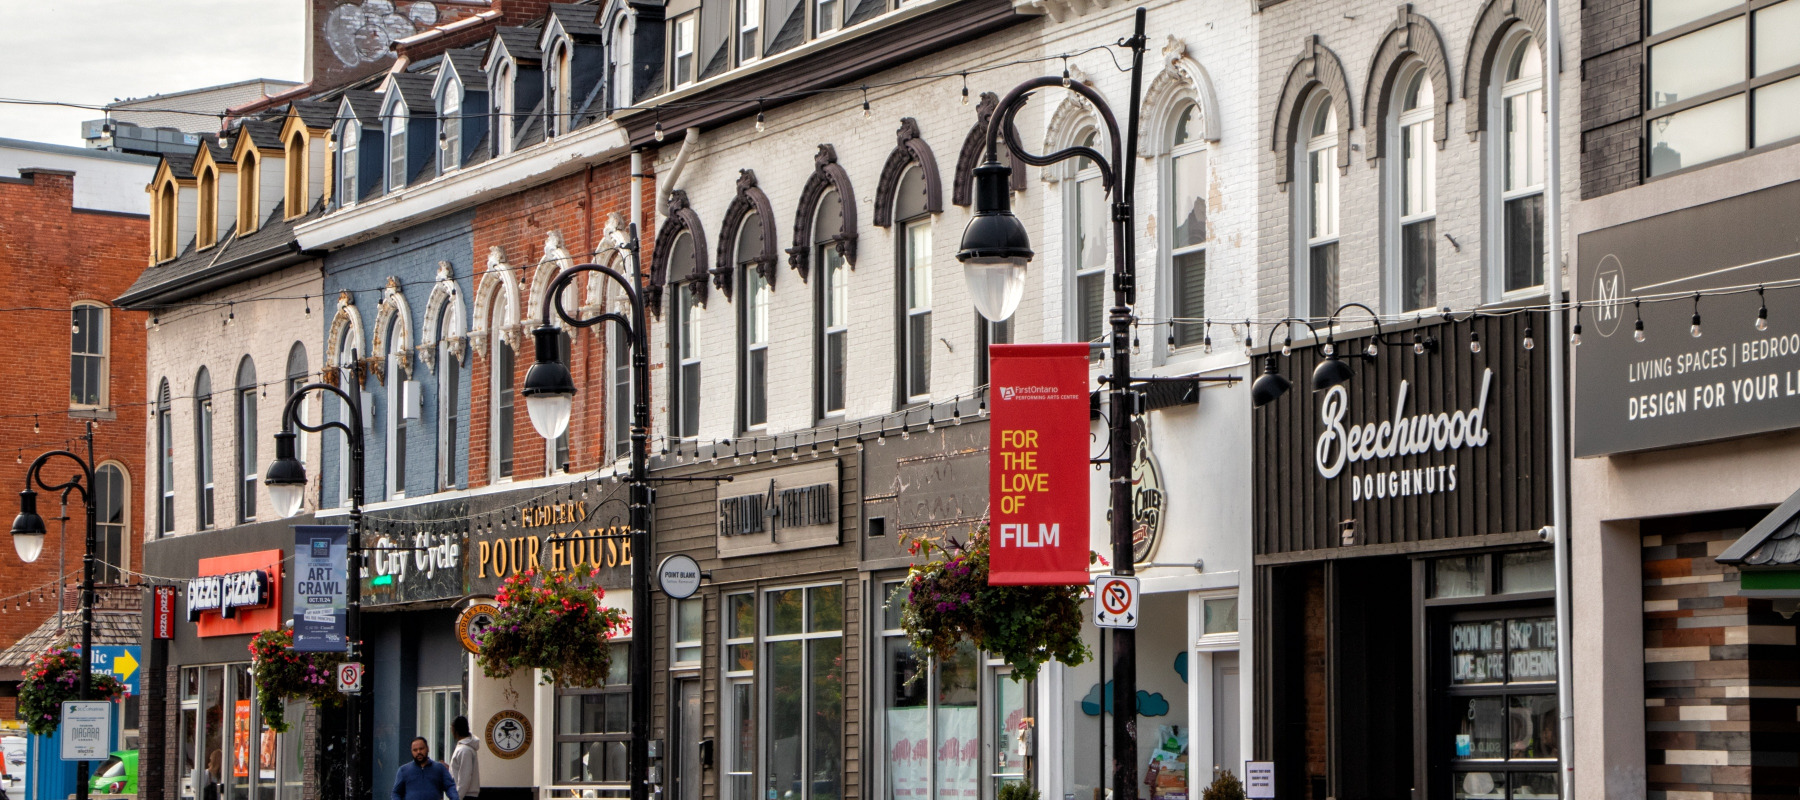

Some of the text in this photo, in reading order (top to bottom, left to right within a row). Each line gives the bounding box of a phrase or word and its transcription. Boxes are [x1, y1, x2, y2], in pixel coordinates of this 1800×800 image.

[1629, 356, 1672, 382] LIVING
[1677, 347, 1727, 374] SPACES
[1629, 389, 1687, 420] DESIGN
[1694, 382, 1725, 410] FOR
[1732, 374, 1778, 404] YOUR
[1316, 368, 1491, 478] Beechwood
[1001, 430, 1039, 449] FOR
[1000, 452, 1037, 470] THE
[1001, 474, 1049, 492] LOVE
[1353, 464, 1456, 501] DOUGHNUTS
[522, 501, 587, 528] FIDDLER'S
[1001, 496, 1026, 514] OF
[1135, 486, 1162, 520] CHIEF
[1000, 523, 1060, 548] FILM
[376, 538, 409, 582] City
[416, 532, 459, 579] Cycle
[478, 526, 632, 578] POUR HOUSE
[308, 568, 332, 580] ART
[187, 570, 259, 622] pizza pizza
[298, 582, 342, 594] CRAWL
[160, 588, 169, 638] pizza pizza
[1510, 623, 1532, 648] SKIP
[1536, 621, 1556, 647] THE
[505, 712, 524, 720] POUR
[72, 727, 100, 741] NIAGARA
